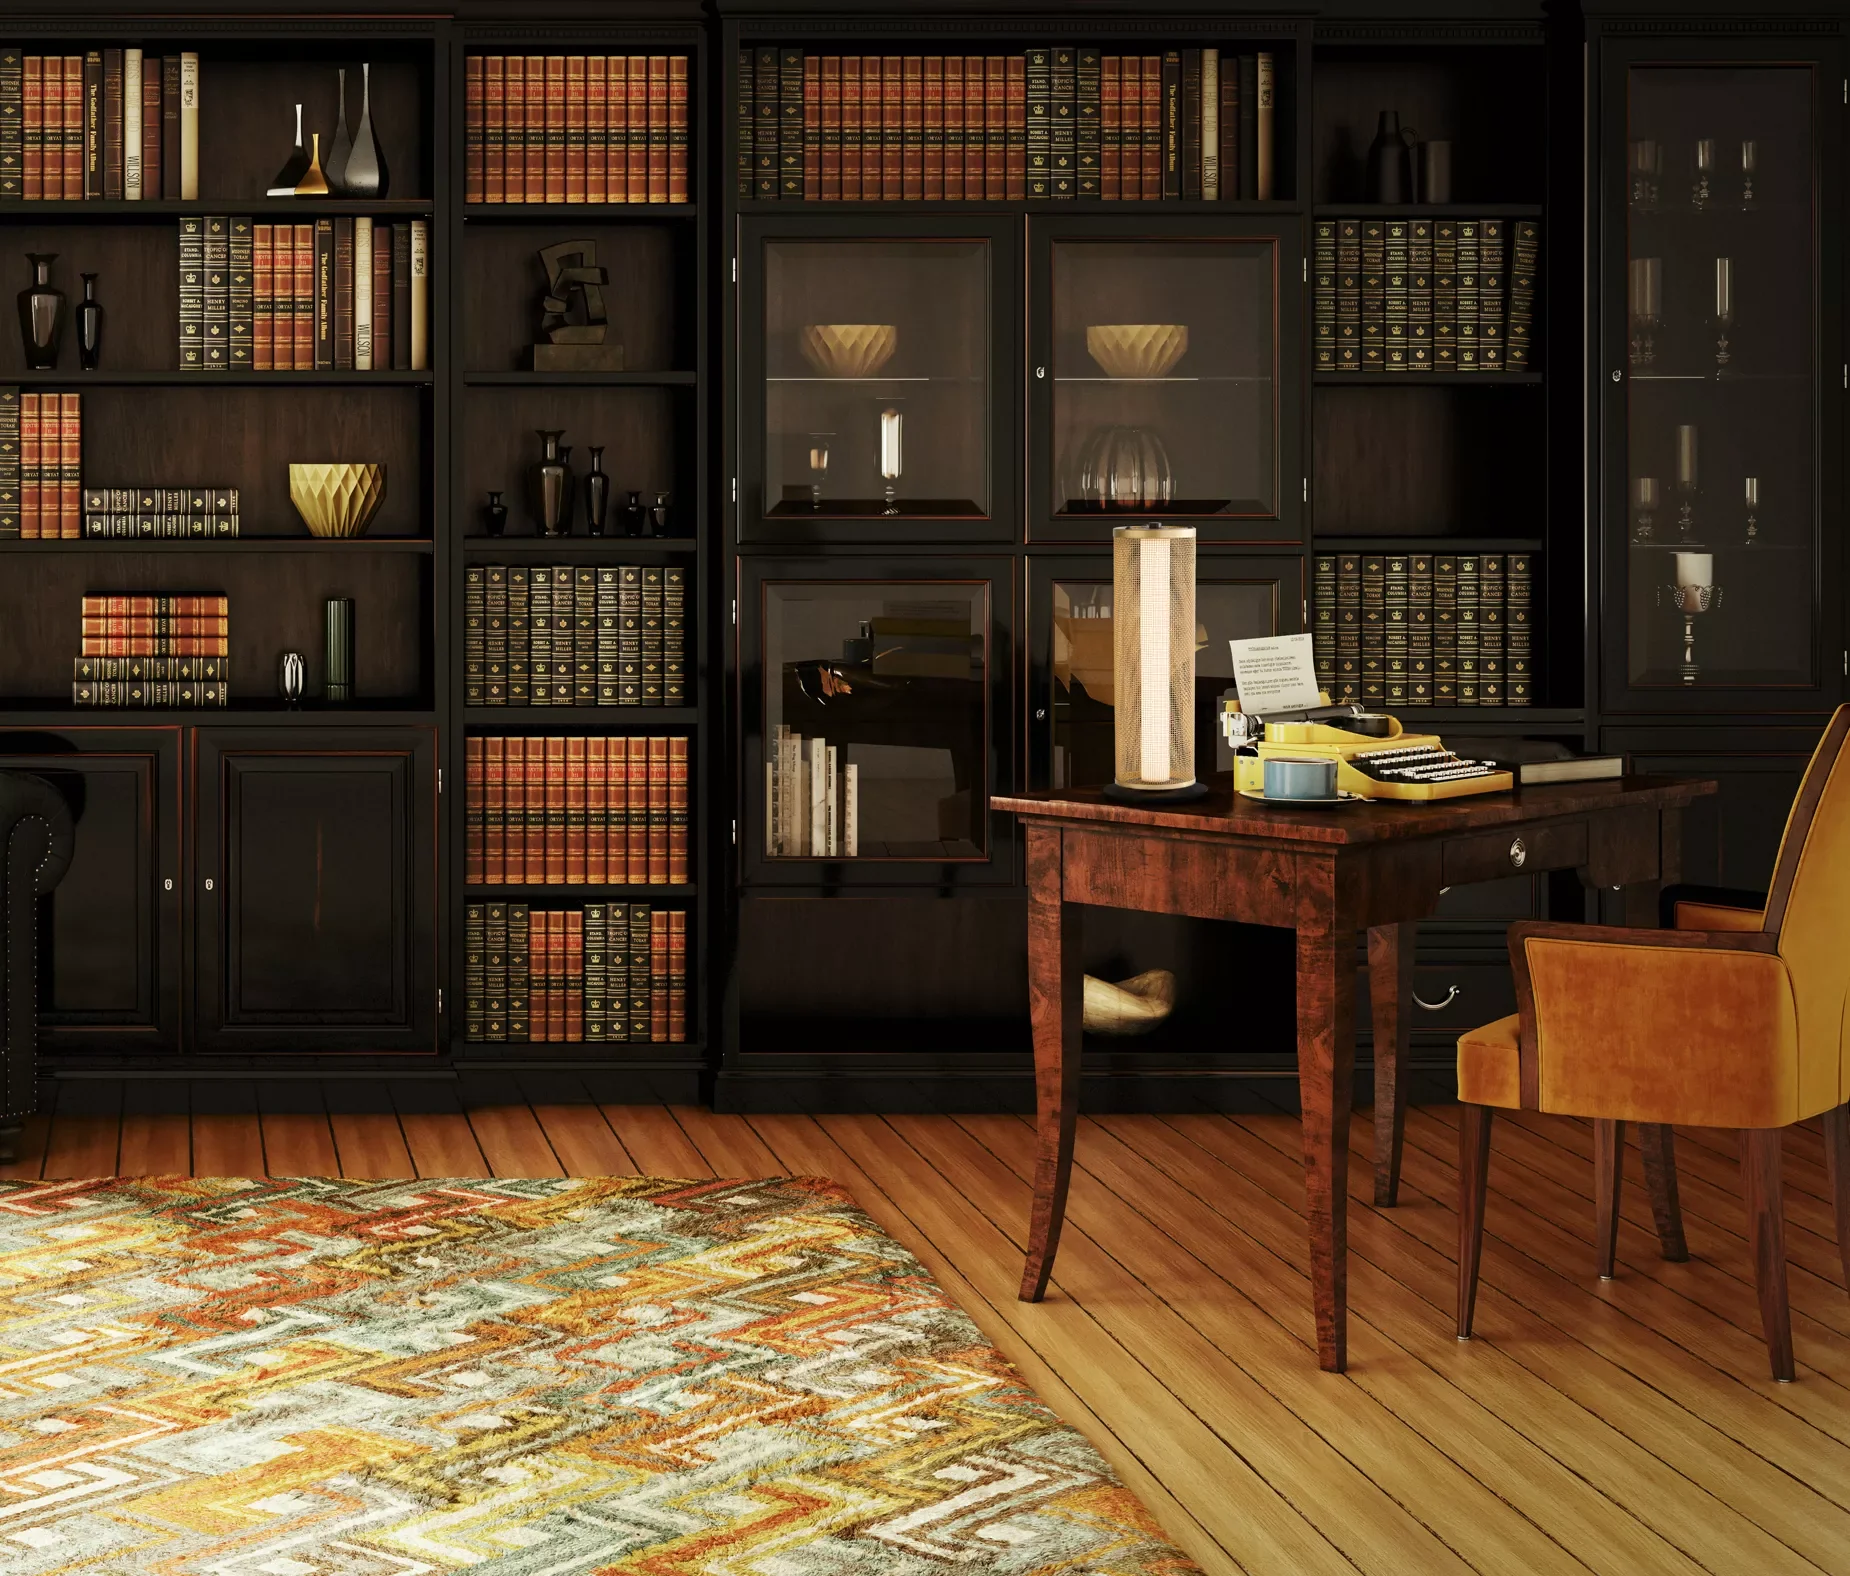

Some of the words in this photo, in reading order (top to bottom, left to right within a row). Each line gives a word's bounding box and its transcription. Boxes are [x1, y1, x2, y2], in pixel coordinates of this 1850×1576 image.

[90, 83, 98, 97] The
[1169, 83, 1177, 97] The
[89, 130, 97, 151] Family
[1168, 130, 1176, 151] Family
[126, 155, 140, 189] WILLSON
[1168, 152, 1176, 172] Album
[1204, 155, 1217, 189] WILLSON
[320, 299, 328, 320] Family
[320, 320, 328, 341] Album
[357, 323, 370, 357] WILLSON
